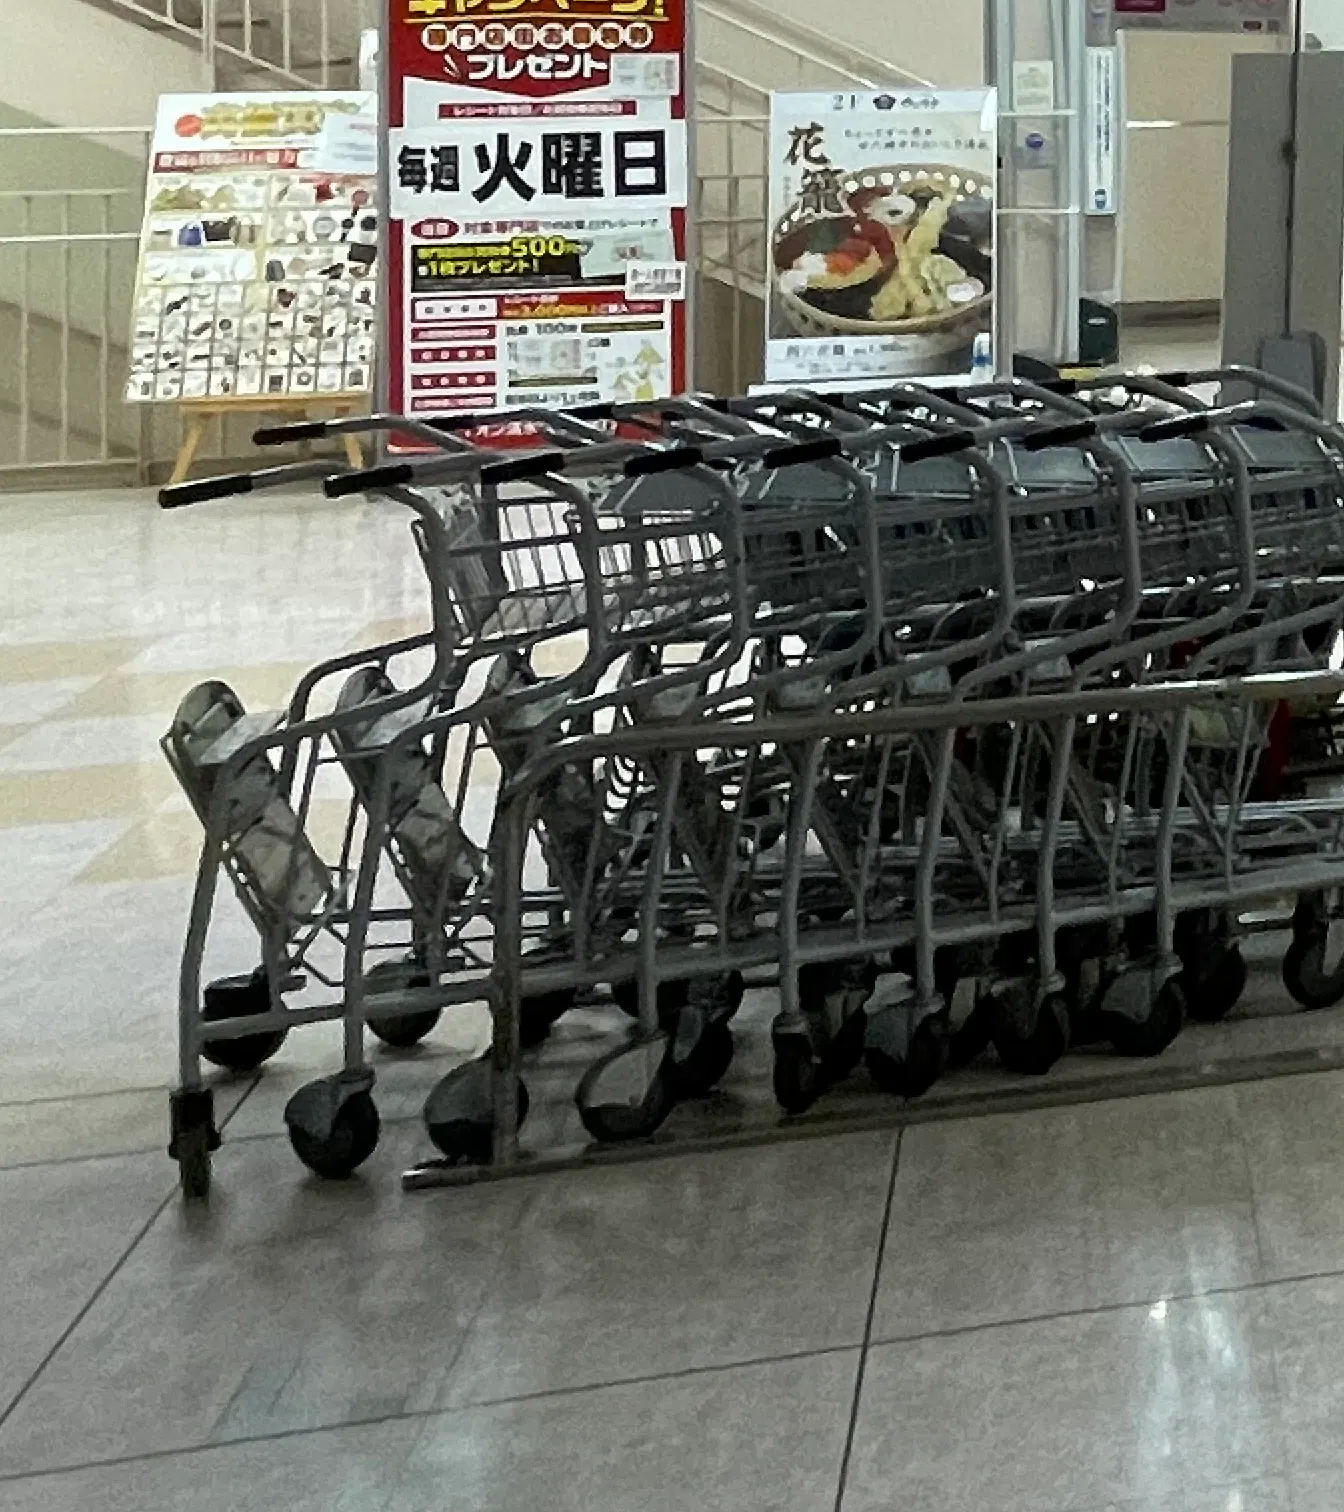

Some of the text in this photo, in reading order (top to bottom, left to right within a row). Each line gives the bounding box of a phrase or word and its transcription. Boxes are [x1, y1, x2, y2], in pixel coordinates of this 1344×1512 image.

[398, 129, 667, 204] 毎週 火曜日
